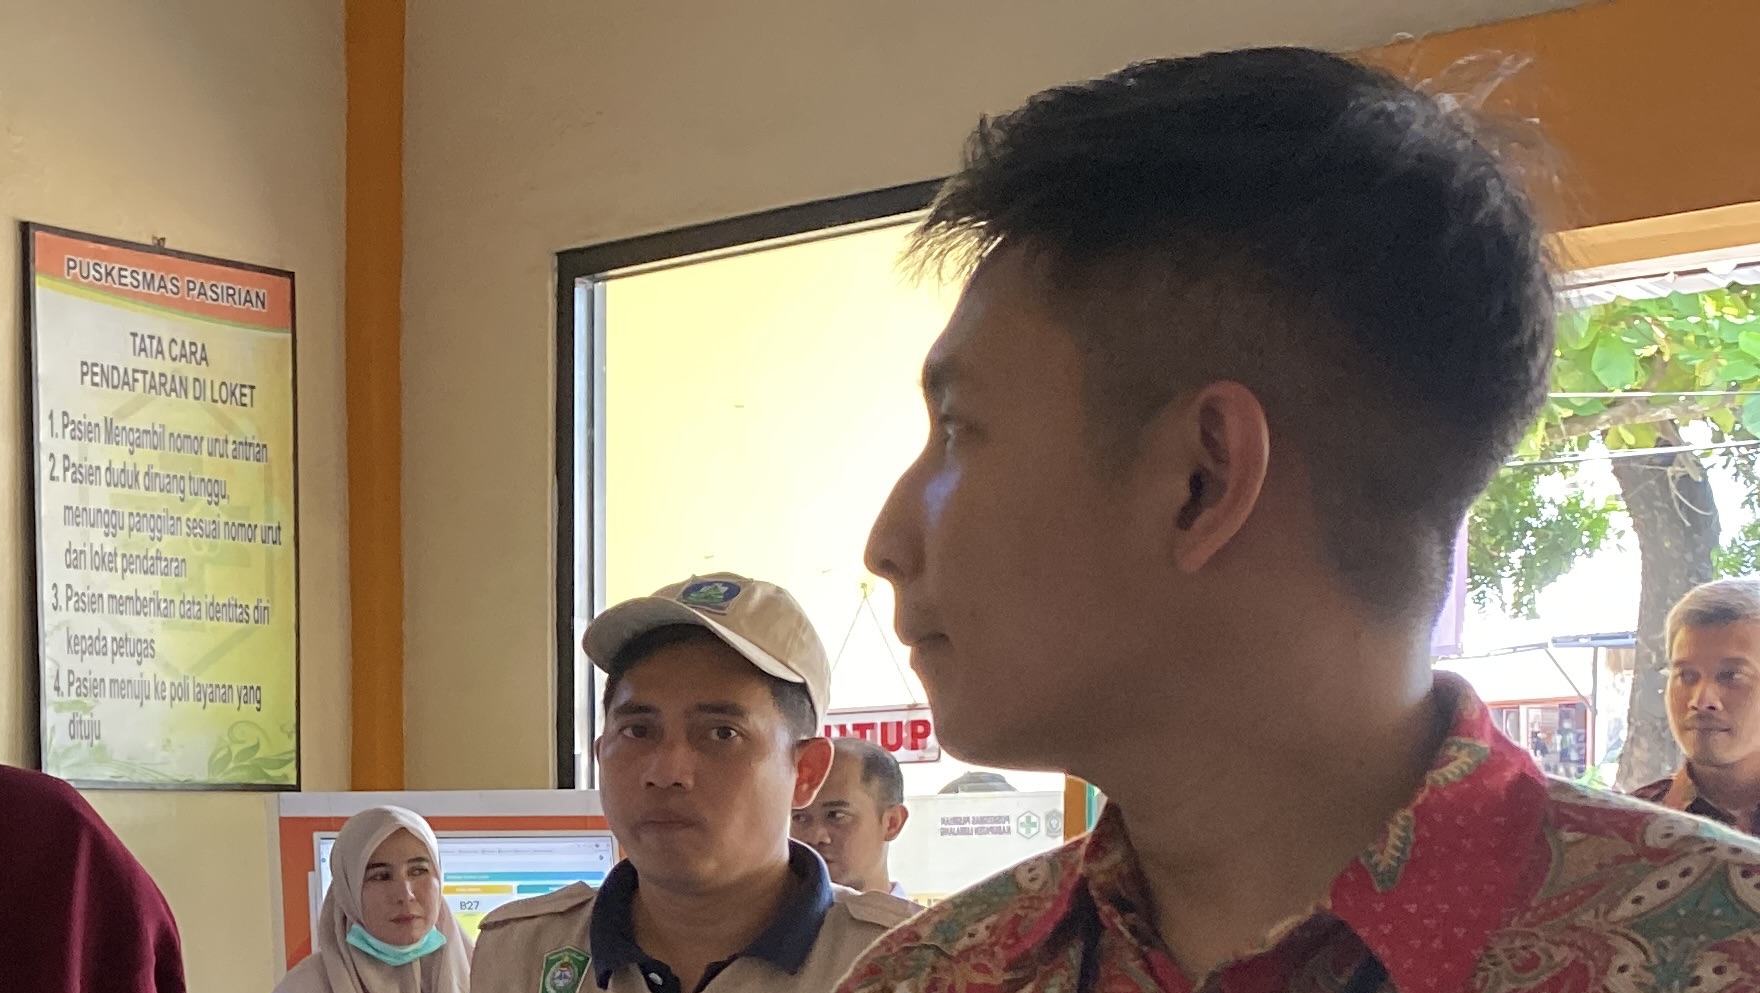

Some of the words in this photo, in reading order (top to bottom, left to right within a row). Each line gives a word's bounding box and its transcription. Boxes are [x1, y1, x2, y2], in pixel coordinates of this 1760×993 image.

[66, 257, 180, 296] PUSKESMAS
[186, 279, 267, 310] PASIRIAN
[129, 332, 165, 361] TATA
[169, 338, 209, 367] CARA
[80, 361, 188, 400] PENDAFTARAN
[193, 377, 206, 401] DI
[211, 381, 256, 408] LOKET
[48, 408, 58, 439] 1.
[62, 410, 100, 444] Pasien
[104, 416, 165, 455] Mengambil
[168, 431, 204, 456] nomor
[207, 434, 229, 460] urut
[231, 435, 268, 464] antrian
[48, 452, 59, 483] 2.
[62, 454, 101, 487] Pasien
[105, 459, 140, 491] duduk
[143, 464, 185, 503] diruang
[63, 504, 124, 538] menunggu
[128, 508, 182, 542] panggilan
[186, 513, 220, 540] sesuai
[223, 520, 257, 544] nomor
[260, 521, 282, 546] urut
[64, 541, 87, 571] dari
[90, 543, 118, 574] loket
[121, 548, 187, 580] pendaftaran
[51, 582, 62, 612] 3.
[65, 583, 104, 614] Pasien
[107, 588, 175, 619] memberikan
[179, 592, 202, 620] data
[205, 594, 250, 624] identitas
[253, 597, 270, 626] diri
[66, 627, 108, 663] kepada
[111, 632, 156, 666] petugas
[53, 668, 64, 698] 4.
[67, 669, 106, 699] Pasien
[109, 672, 151, 708] menuju
[153, 674, 167, 702] ke
[170, 675, 190, 709] poli
[192, 676, 234, 710] layanan
[236, 683, 262, 712] yang
[68, 712, 101, 748] dituju
[824, 718, 932, 753] UTUP
[459, 900, 480, 911] B27
